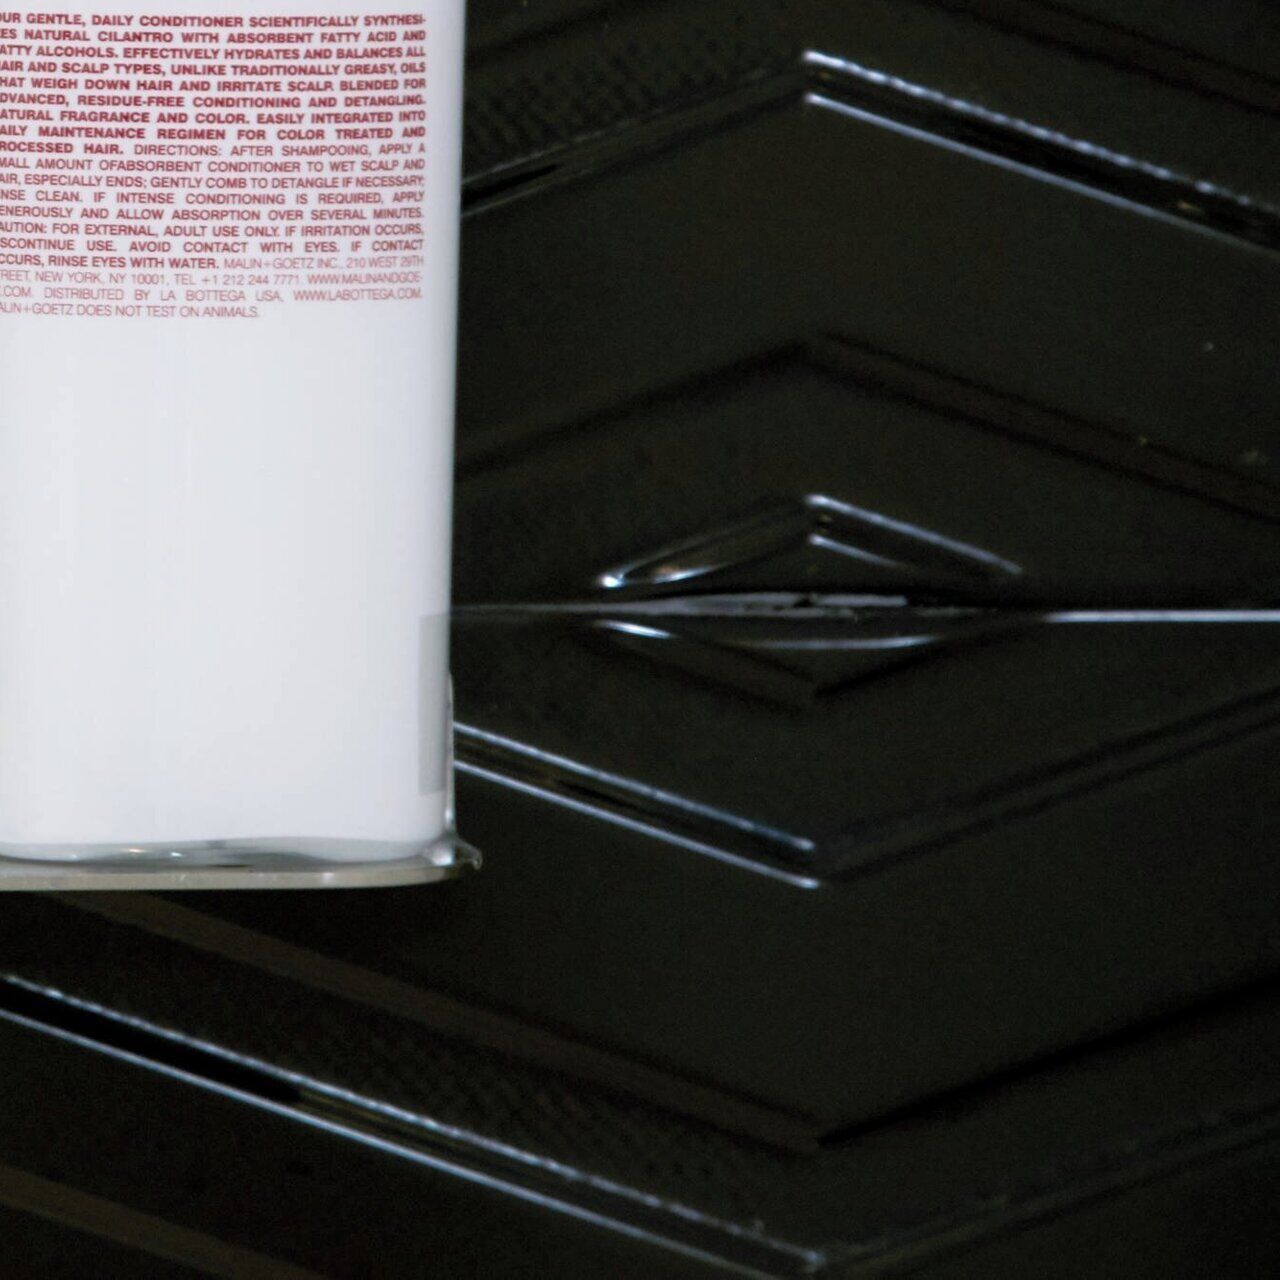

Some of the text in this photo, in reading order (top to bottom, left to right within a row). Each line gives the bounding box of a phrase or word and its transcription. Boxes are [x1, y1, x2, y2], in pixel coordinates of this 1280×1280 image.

[25, 12, 86, 28] GENTLE,
[90, 14, 134, 27] DAILY
[138, 15, 245, 28] CONDITIONER
[248, 15, 359, 28] SCIENTIFICALLY
[23, 29, 91, 42] NATURAL
[96, 30, 175, 44] CILANTRO
[180, 31, 221, 44] WITH
[226, 32, 314, 44] ABSORBENT
[319, 31, 361, 44] FATTY
[366, 30, 398, 43] ACID
[402, 29, 427, 42] AND
[76, 94, 186, 108] RESIDUE-FREE
[191, 96, 302, 109] CONDITIONING
[307, 96, 338, 108] AND
[343, 93, 425, 108] DETANGLING.
[59, 110, 151, 124] FRAGRANCE
[156, 112, 189, 124] AND
[194, 112, 250, 125] COLOR.
[255, 112, 305, 125] EASILY
[310, 111, 394, 124] INTEGRATED
[397, 109, 427, 122] INTO
[79, 207, 110, 220] AND
[115, 208, 165, 221] ALLOW
[171, 208, 262, 221] ABSORPTION
[267, 209, 305, 222] OVER
[309, 208, 367, 222] SEVERAL
[371, 206, 423, 220] MINUTES.
